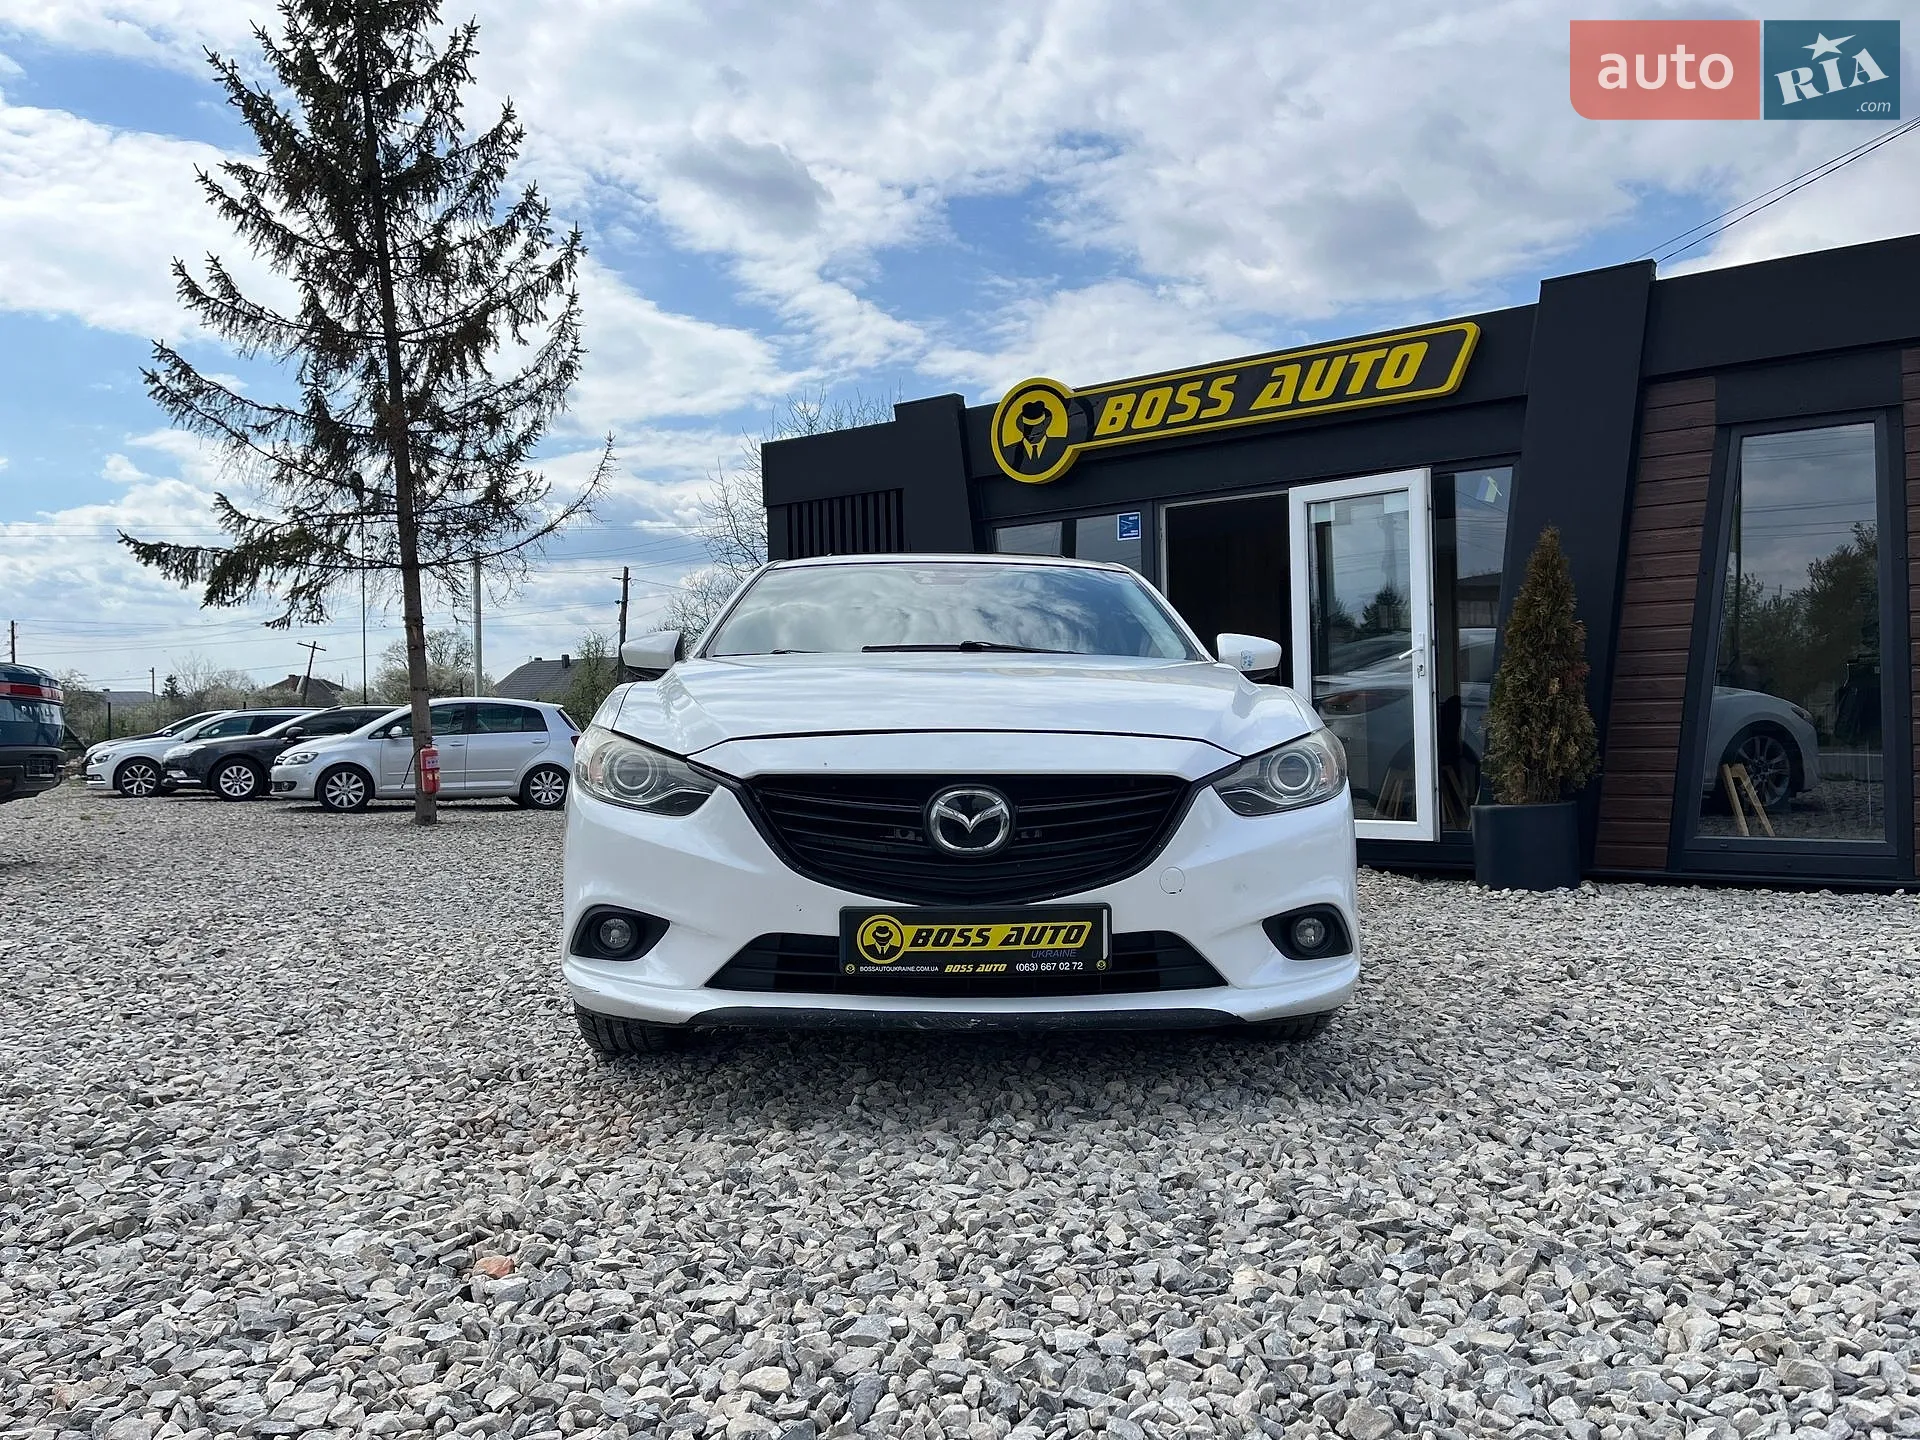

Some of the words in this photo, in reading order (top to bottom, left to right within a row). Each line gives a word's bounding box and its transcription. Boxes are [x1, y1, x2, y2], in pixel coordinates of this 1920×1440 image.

[1094, 374, 1238, 437] BOSS
[1249, 341, 1429, 411] AUTO
[908, 926, 993, 948] BOSS
[998, 924, 1087, 947] AUTO
[1031, 949, 1077, 959] UKRAINE
[944, 964, 974, 973] BOSS
[975, 963, 1007, 973] AUTO
[1015, 962, 1038, 972] (063)
[1040, 962, 1057, 971] 667
[1059, 962, 1070, 971] 02
[1072, 961, 1083, 970] 72
